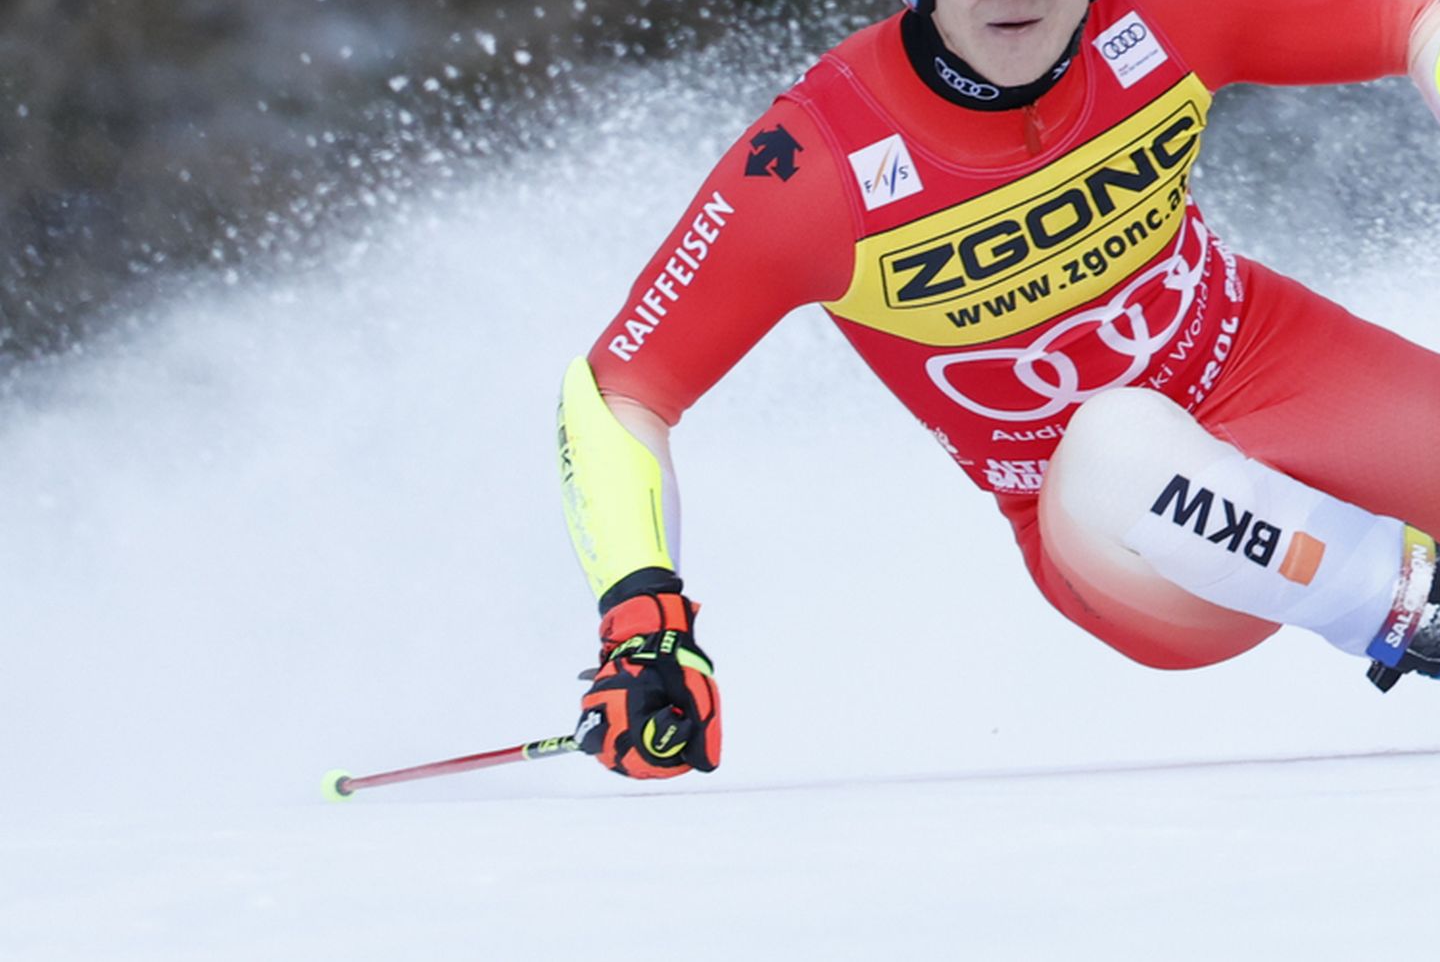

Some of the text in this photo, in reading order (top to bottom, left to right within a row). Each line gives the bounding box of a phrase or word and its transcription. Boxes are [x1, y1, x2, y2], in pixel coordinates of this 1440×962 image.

[892, 116, 1197, 302] ZGONC
[608, 191, 735, 362] RAIFFEISEN
[1170, 281, 1209, 362] World
[991, 424, 1067, 442] Audi
[1150, 473, 1282, 568] BKW
